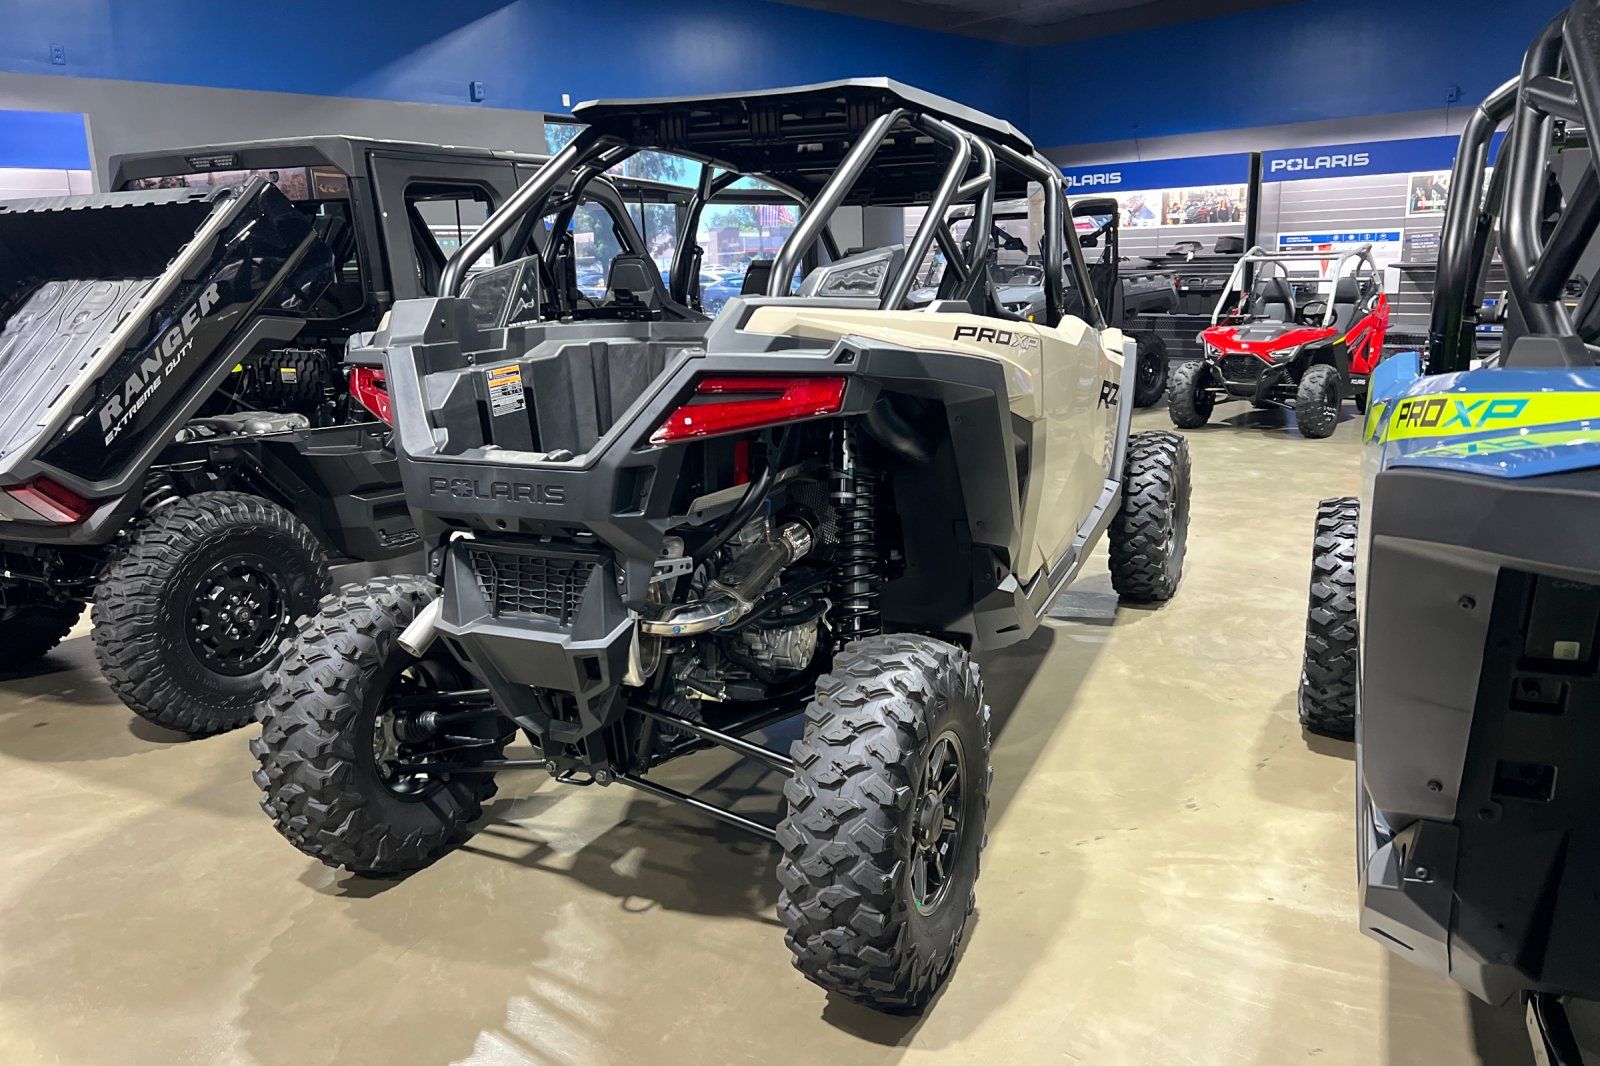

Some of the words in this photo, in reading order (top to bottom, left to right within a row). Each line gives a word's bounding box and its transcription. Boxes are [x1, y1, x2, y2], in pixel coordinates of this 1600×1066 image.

[1271, 153, 1370, 173] POLARIS
[1064, 172, 1121, 187] OLARIS
[99, 282, 221, 432] RANGER
[104, 375, 163, 447] EXTREME
[165, 336, 194, 377] DUTY
[428, 477, 567, 506] POLARIS
